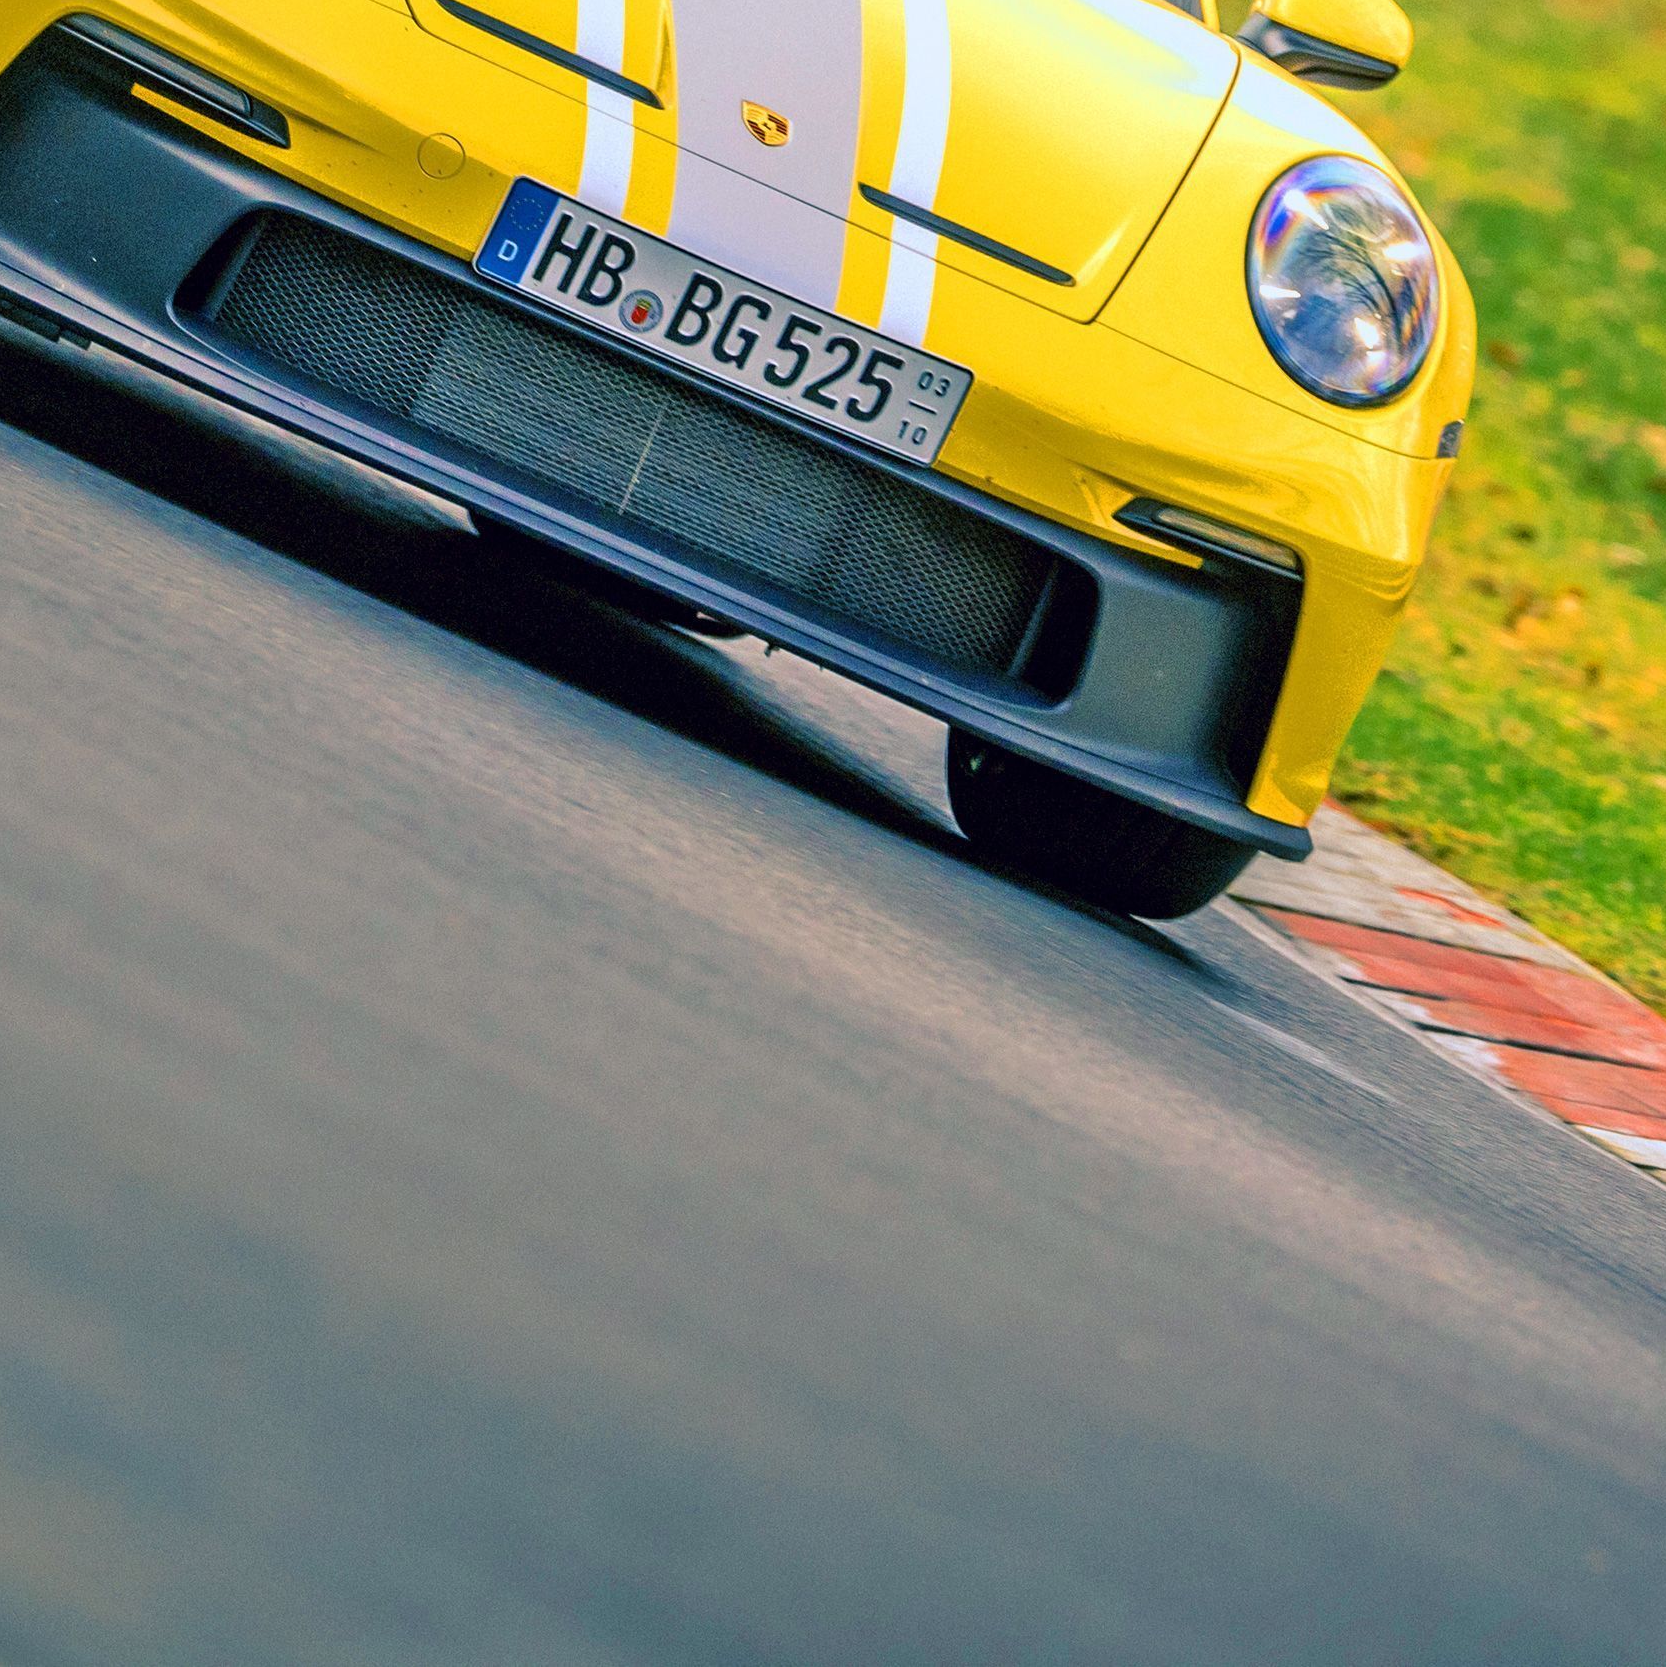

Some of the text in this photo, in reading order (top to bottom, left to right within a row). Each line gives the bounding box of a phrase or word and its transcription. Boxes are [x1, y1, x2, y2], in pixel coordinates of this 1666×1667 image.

[498, 239, 518, 262] D
[532, 212, 636, 306] HB
[918, 370, 951, 397] 03
[898, 420, 928, 445] 10
